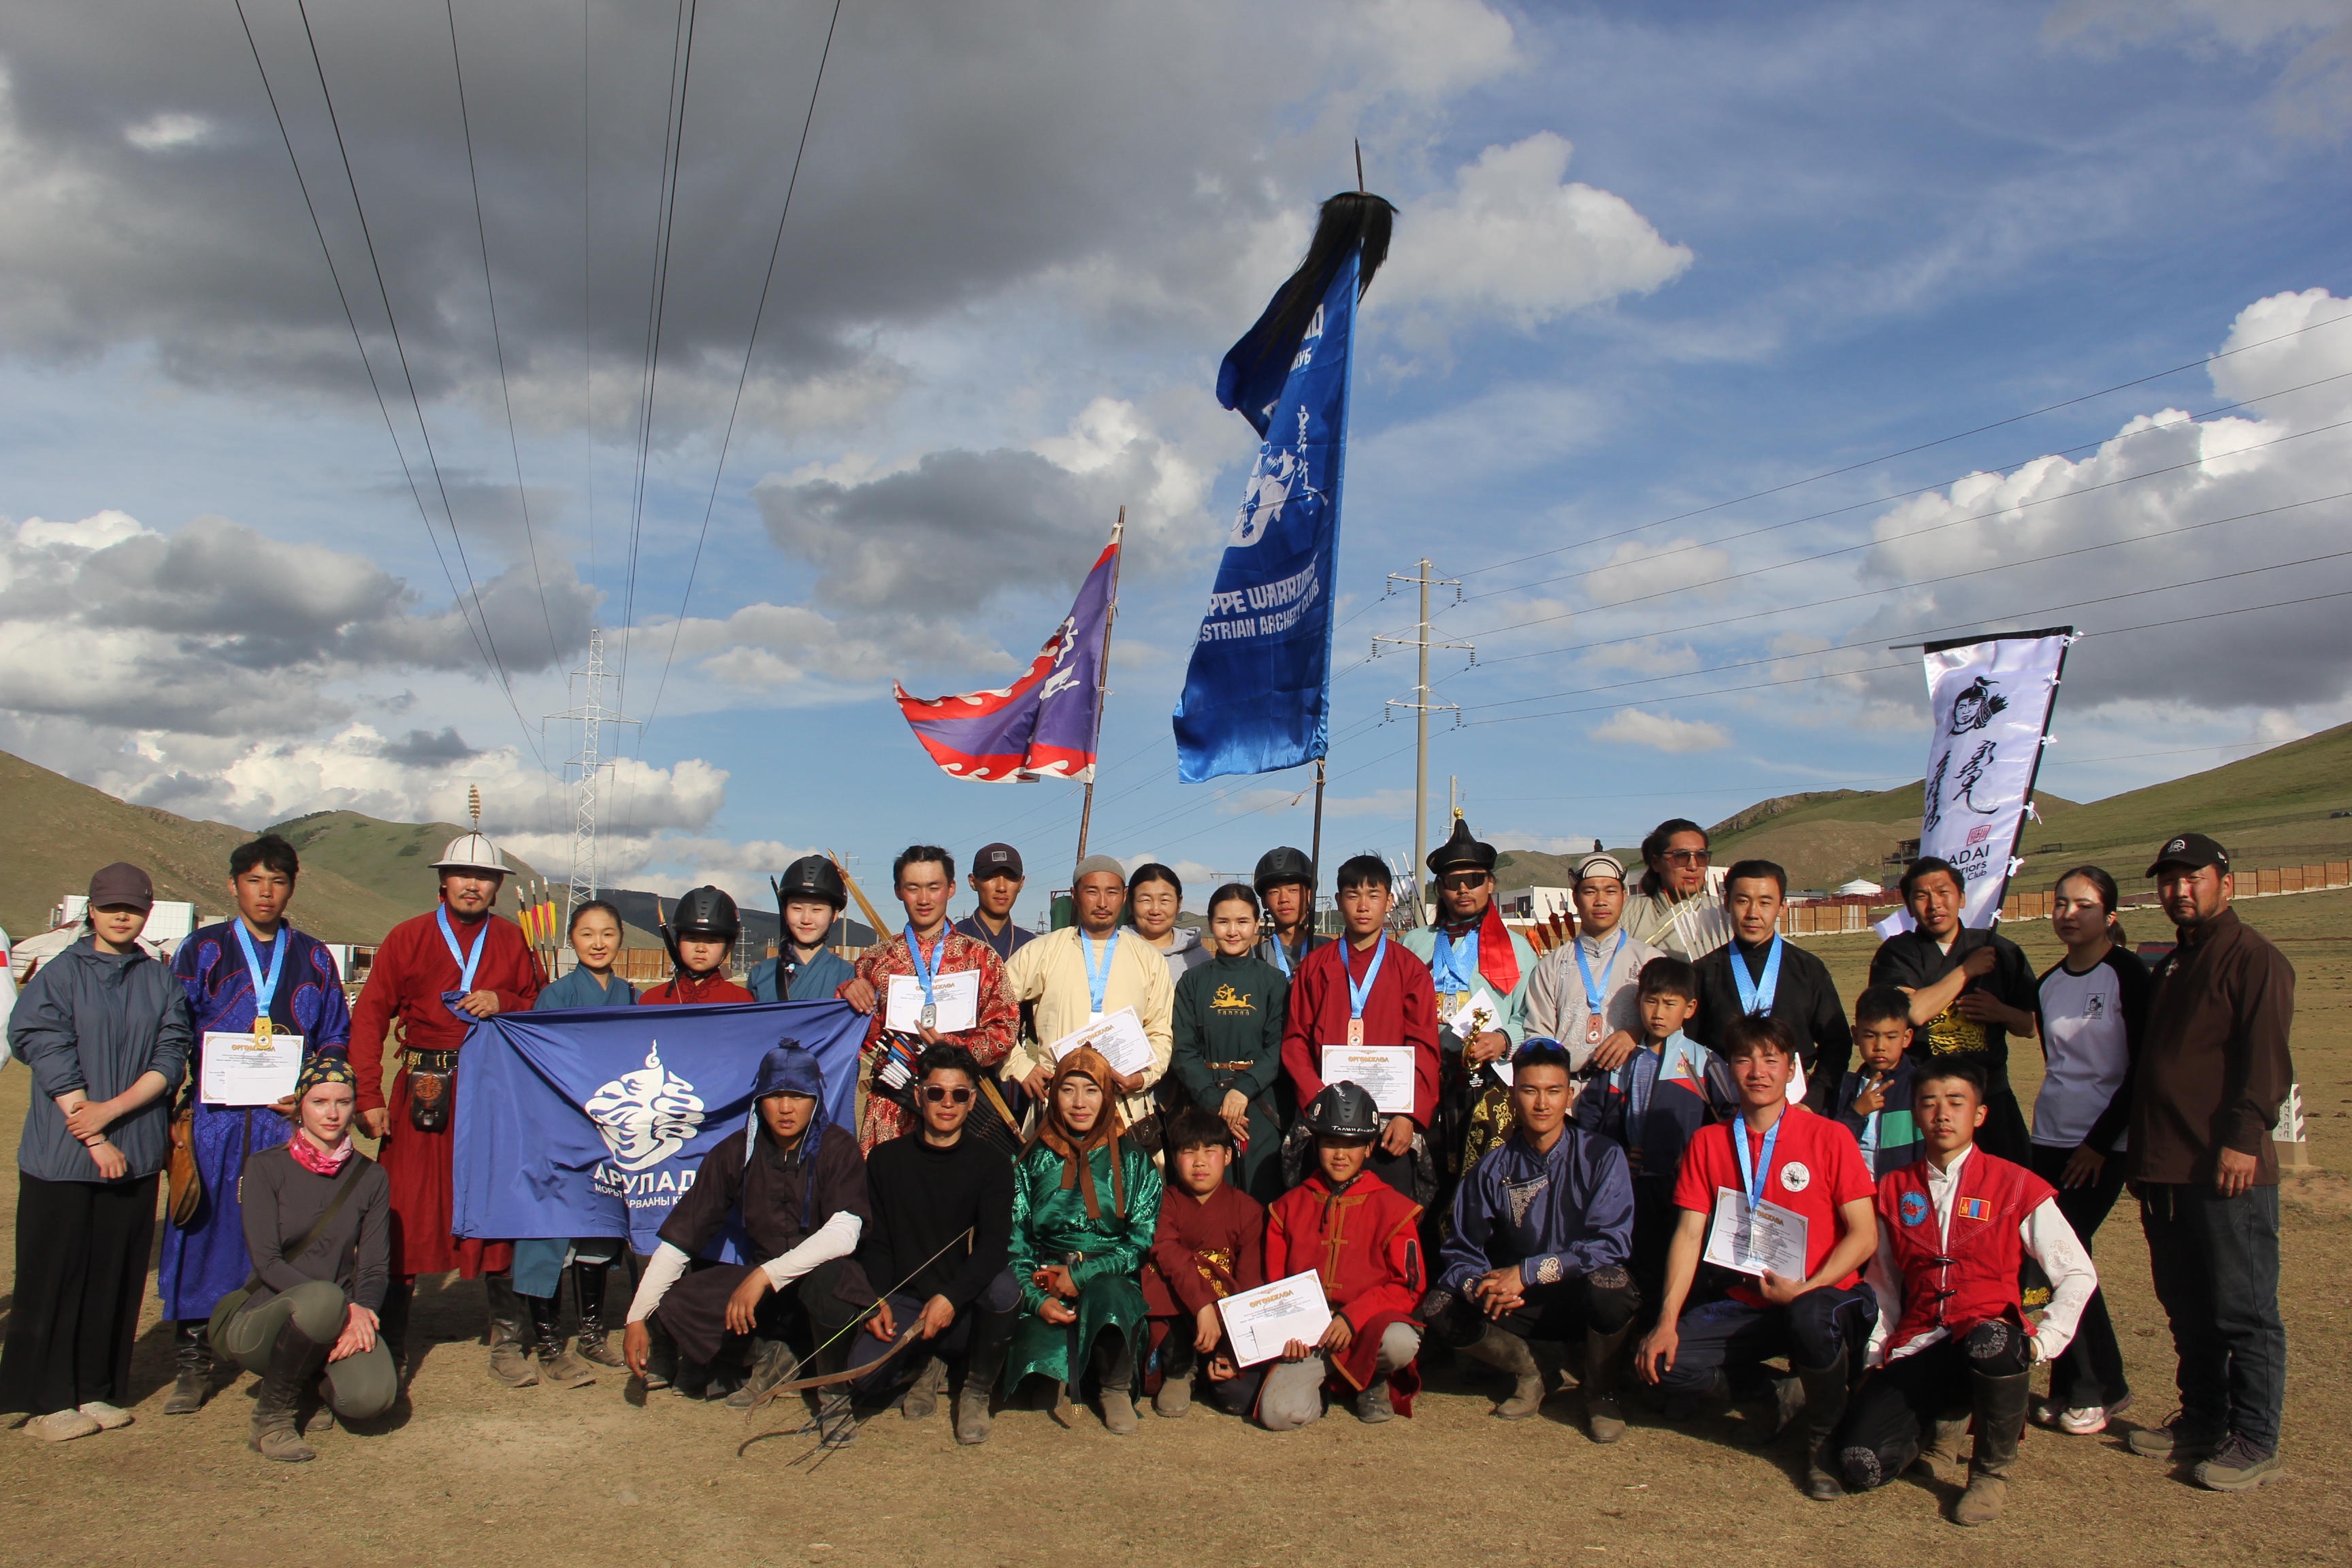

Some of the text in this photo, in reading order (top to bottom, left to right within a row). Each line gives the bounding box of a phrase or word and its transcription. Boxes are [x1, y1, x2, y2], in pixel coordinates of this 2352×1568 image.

[1290, 347, 1312, 373] ЛУБ
[1198, 577, 1319, 642] STRIAN ARCHERY CLUB
[1206, 591, 1247, 617] PPE
[1948, 844, 1990, 866] ADAI
[1959, 861, 1987, 874] riors
[1967, 870, 1987, 881] Club
[593, 1162, 697, 1196] АРУЛАД
[1744, 1206, 1784, 1226] ӨГӨМЖЛӨЛ
[1249, 1290, 1294, 1308] ӨРГӨМЖЛӨЛ
